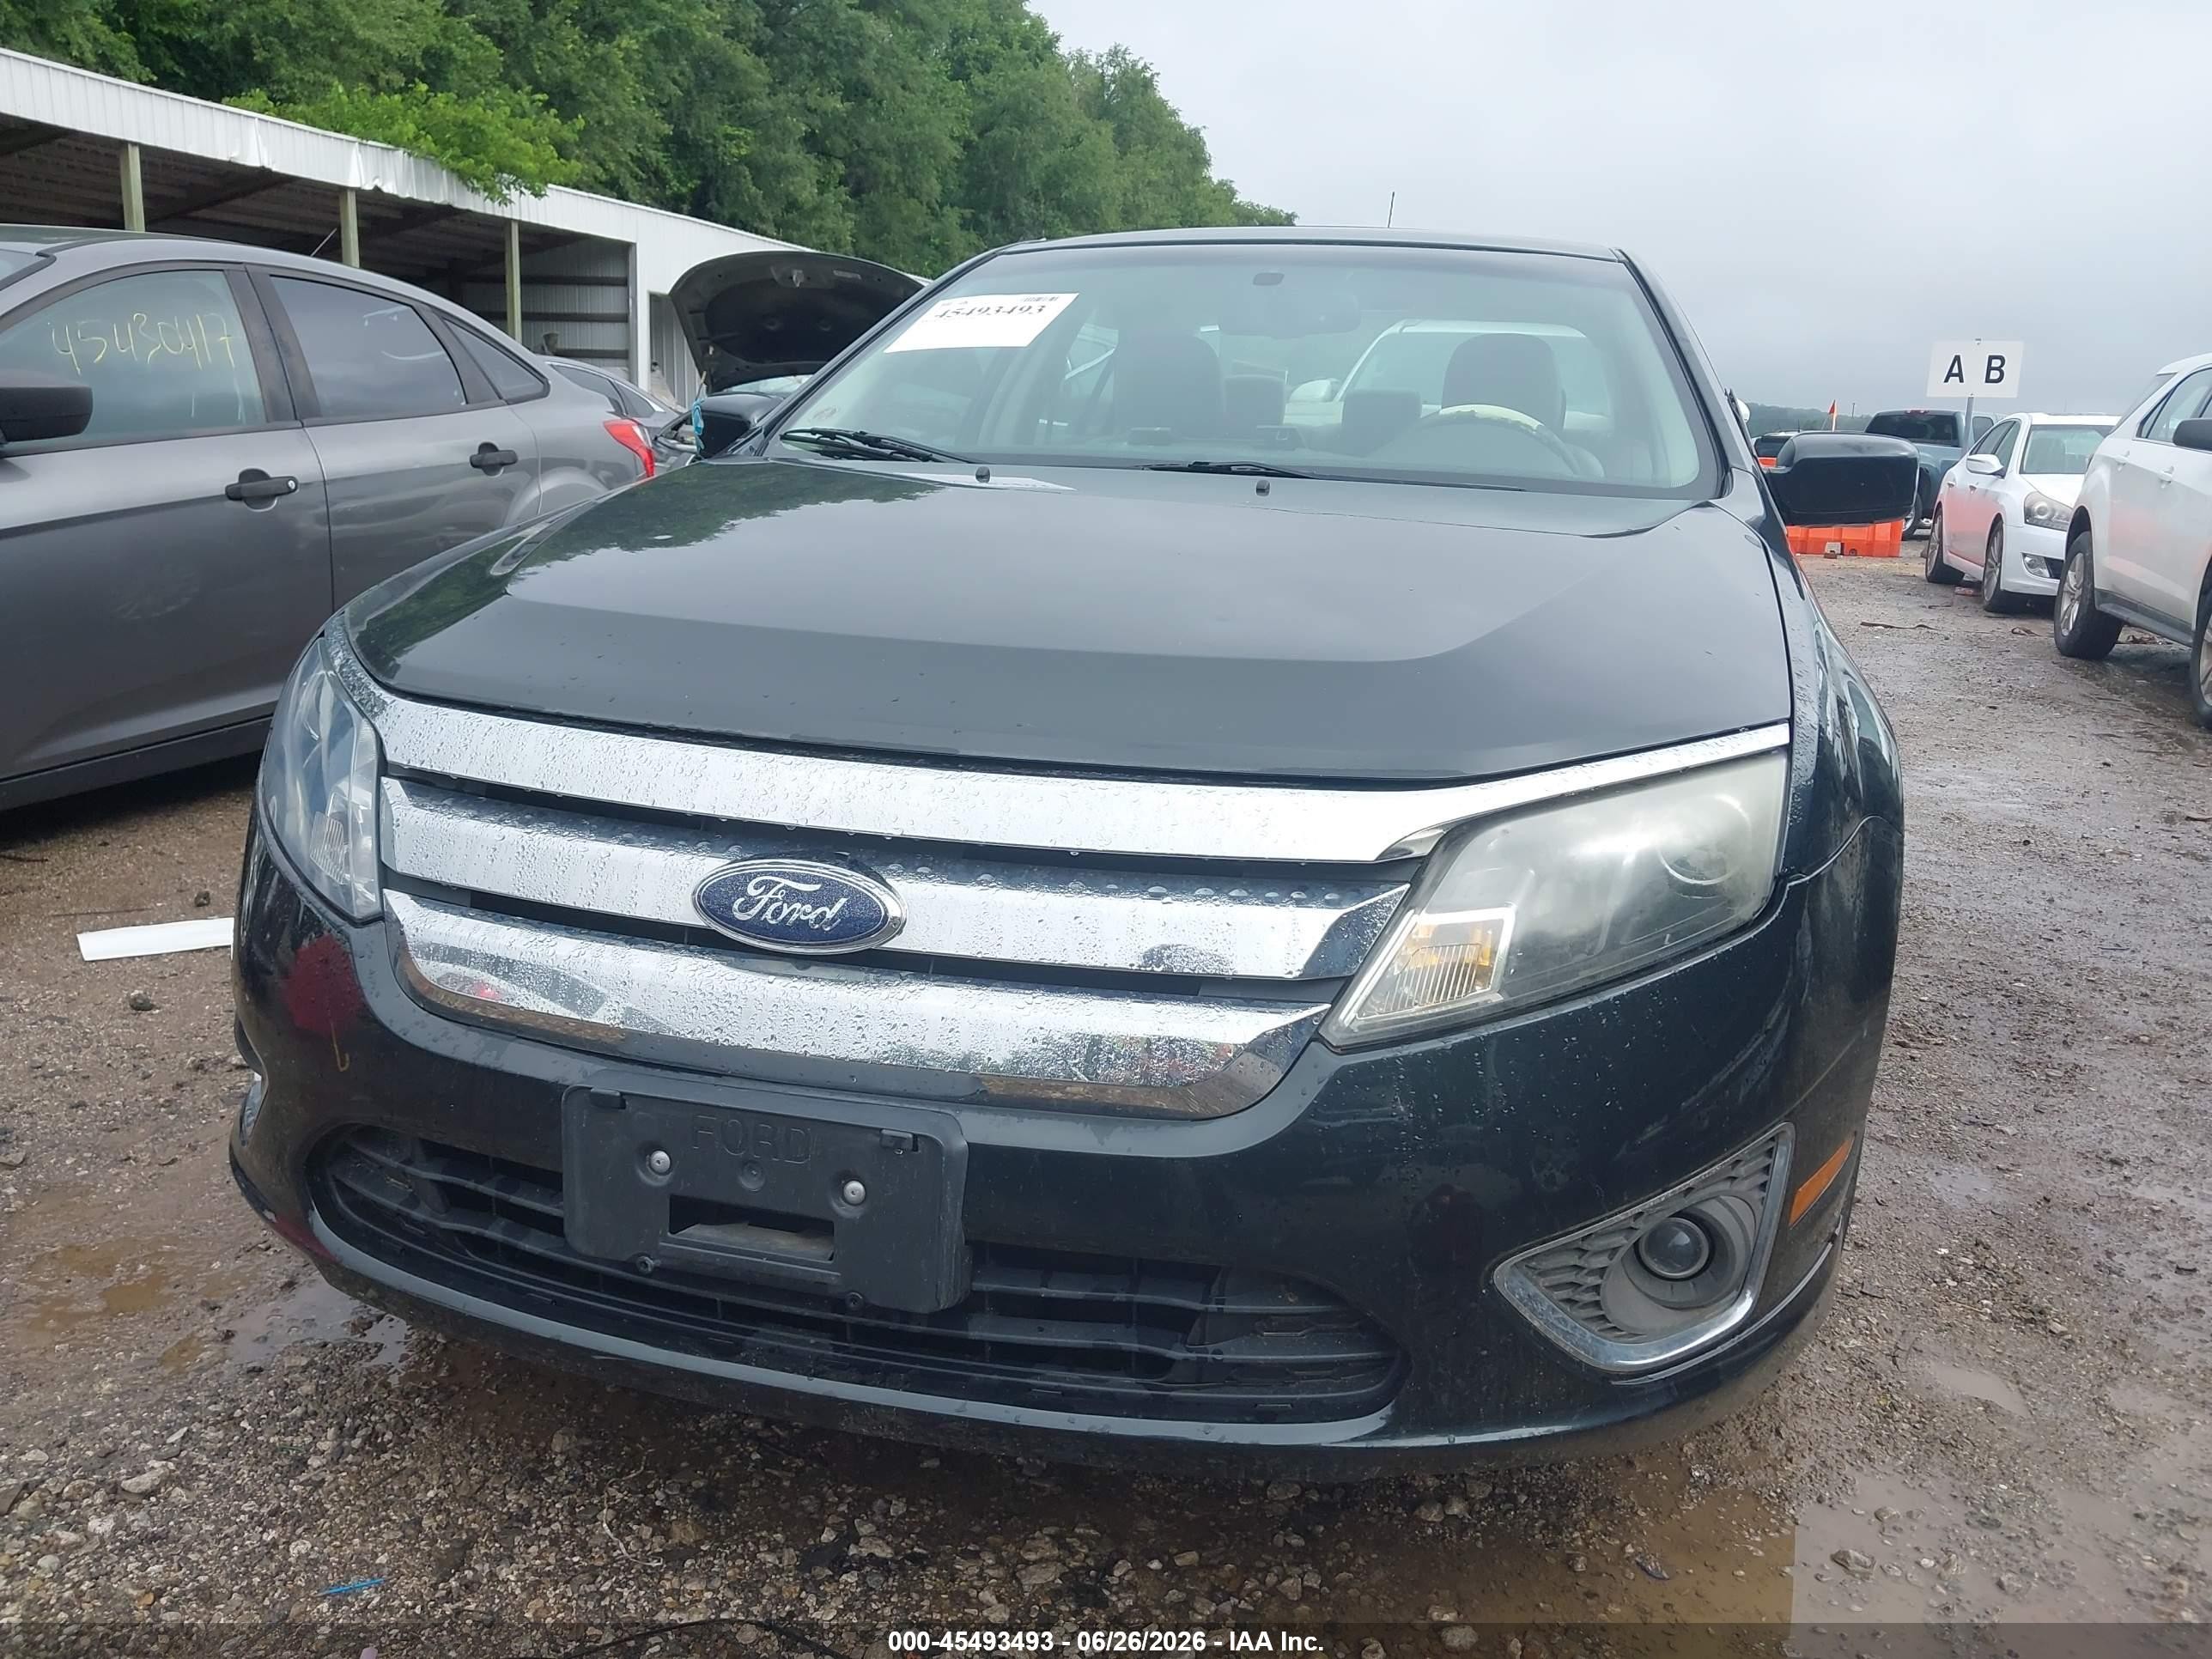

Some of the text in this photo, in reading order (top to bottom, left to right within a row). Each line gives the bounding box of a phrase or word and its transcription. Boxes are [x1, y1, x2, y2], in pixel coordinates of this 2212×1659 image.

[934, 305, 1047, 319] 45493493
[51, 313, 236, 375] 45430417
[1943, 354, 2006, 384] A B
[732, 875, 848, 932] Ford
[690, 1115, 813, 1164] FORD
